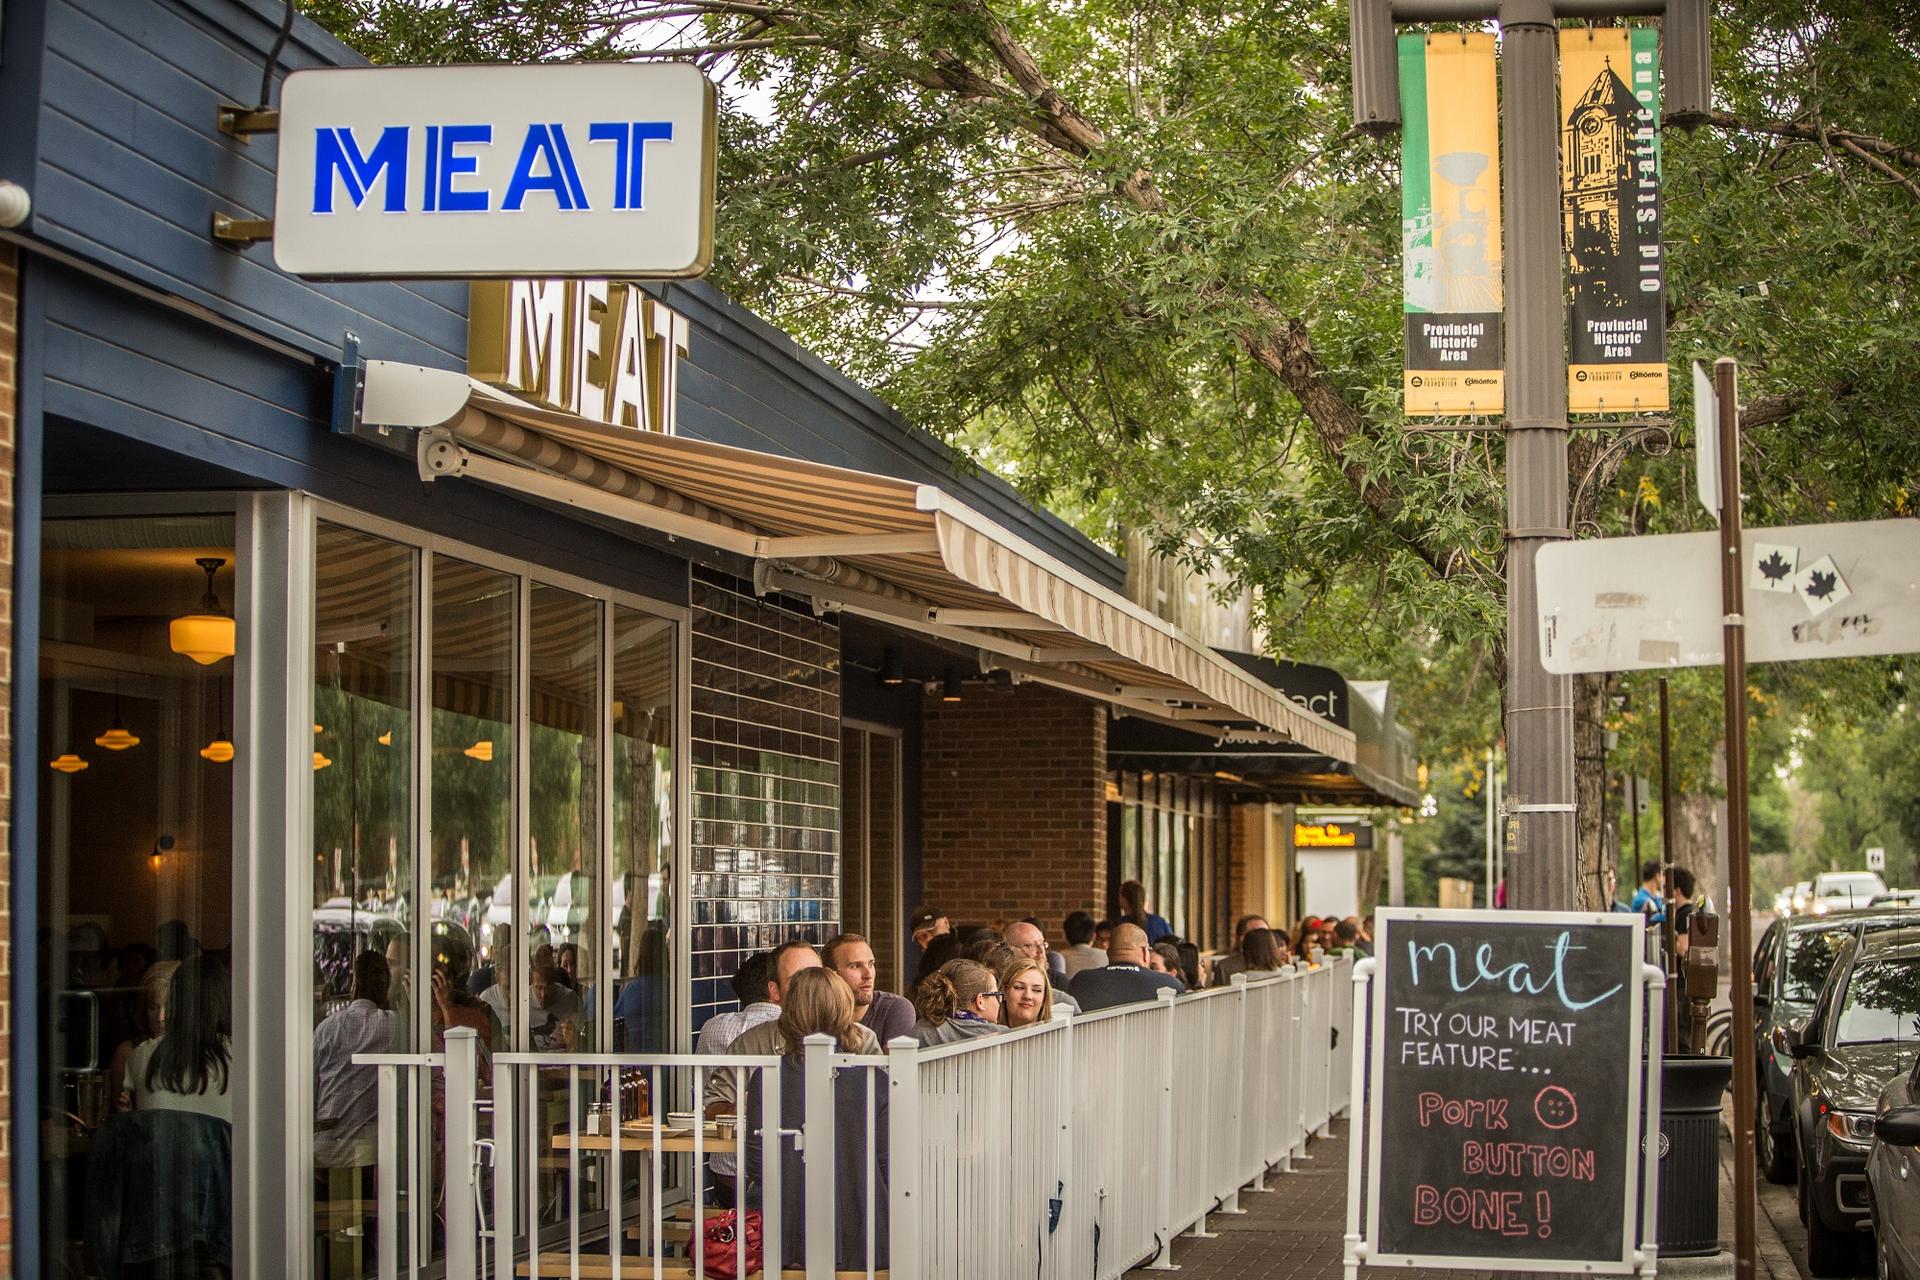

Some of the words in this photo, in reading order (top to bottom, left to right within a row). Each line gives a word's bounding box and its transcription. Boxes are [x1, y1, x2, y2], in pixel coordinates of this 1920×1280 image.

[1635, 52, 1657, 222] Strathcona
[312, 121, 674, 215] MEAT
[1639, 245, 1661, 292] Old
[1423, 323, 1484, 336] Provincial
[1587, 318, 1648, 332] Provincial
[1594, 332, 1642, 345] Historic
[506, 280, 689, 436] MEAT
[1430, 336, 1478, 349] Historic
[1440, 349, 1468, 361] Area
[1604, 345, 1632, 357] Area
[1464, 377, 1498, 386] Edmonton
[1629, 371, 1663, 380] Edmonton
[1408, 931, 1624, 1011] meat
[1396, 1007, 1442, 1037] TRY
[1449, 1013, 1499, 1039] OUR
[1509, 1016, 1577, 1046] MEAT
[1401, 1042, 1552, 1074] FEATURE...
[1463, 1140, 1595, 1181] BUTTON
[1414, 1184, 1552, 1238] BONE!
